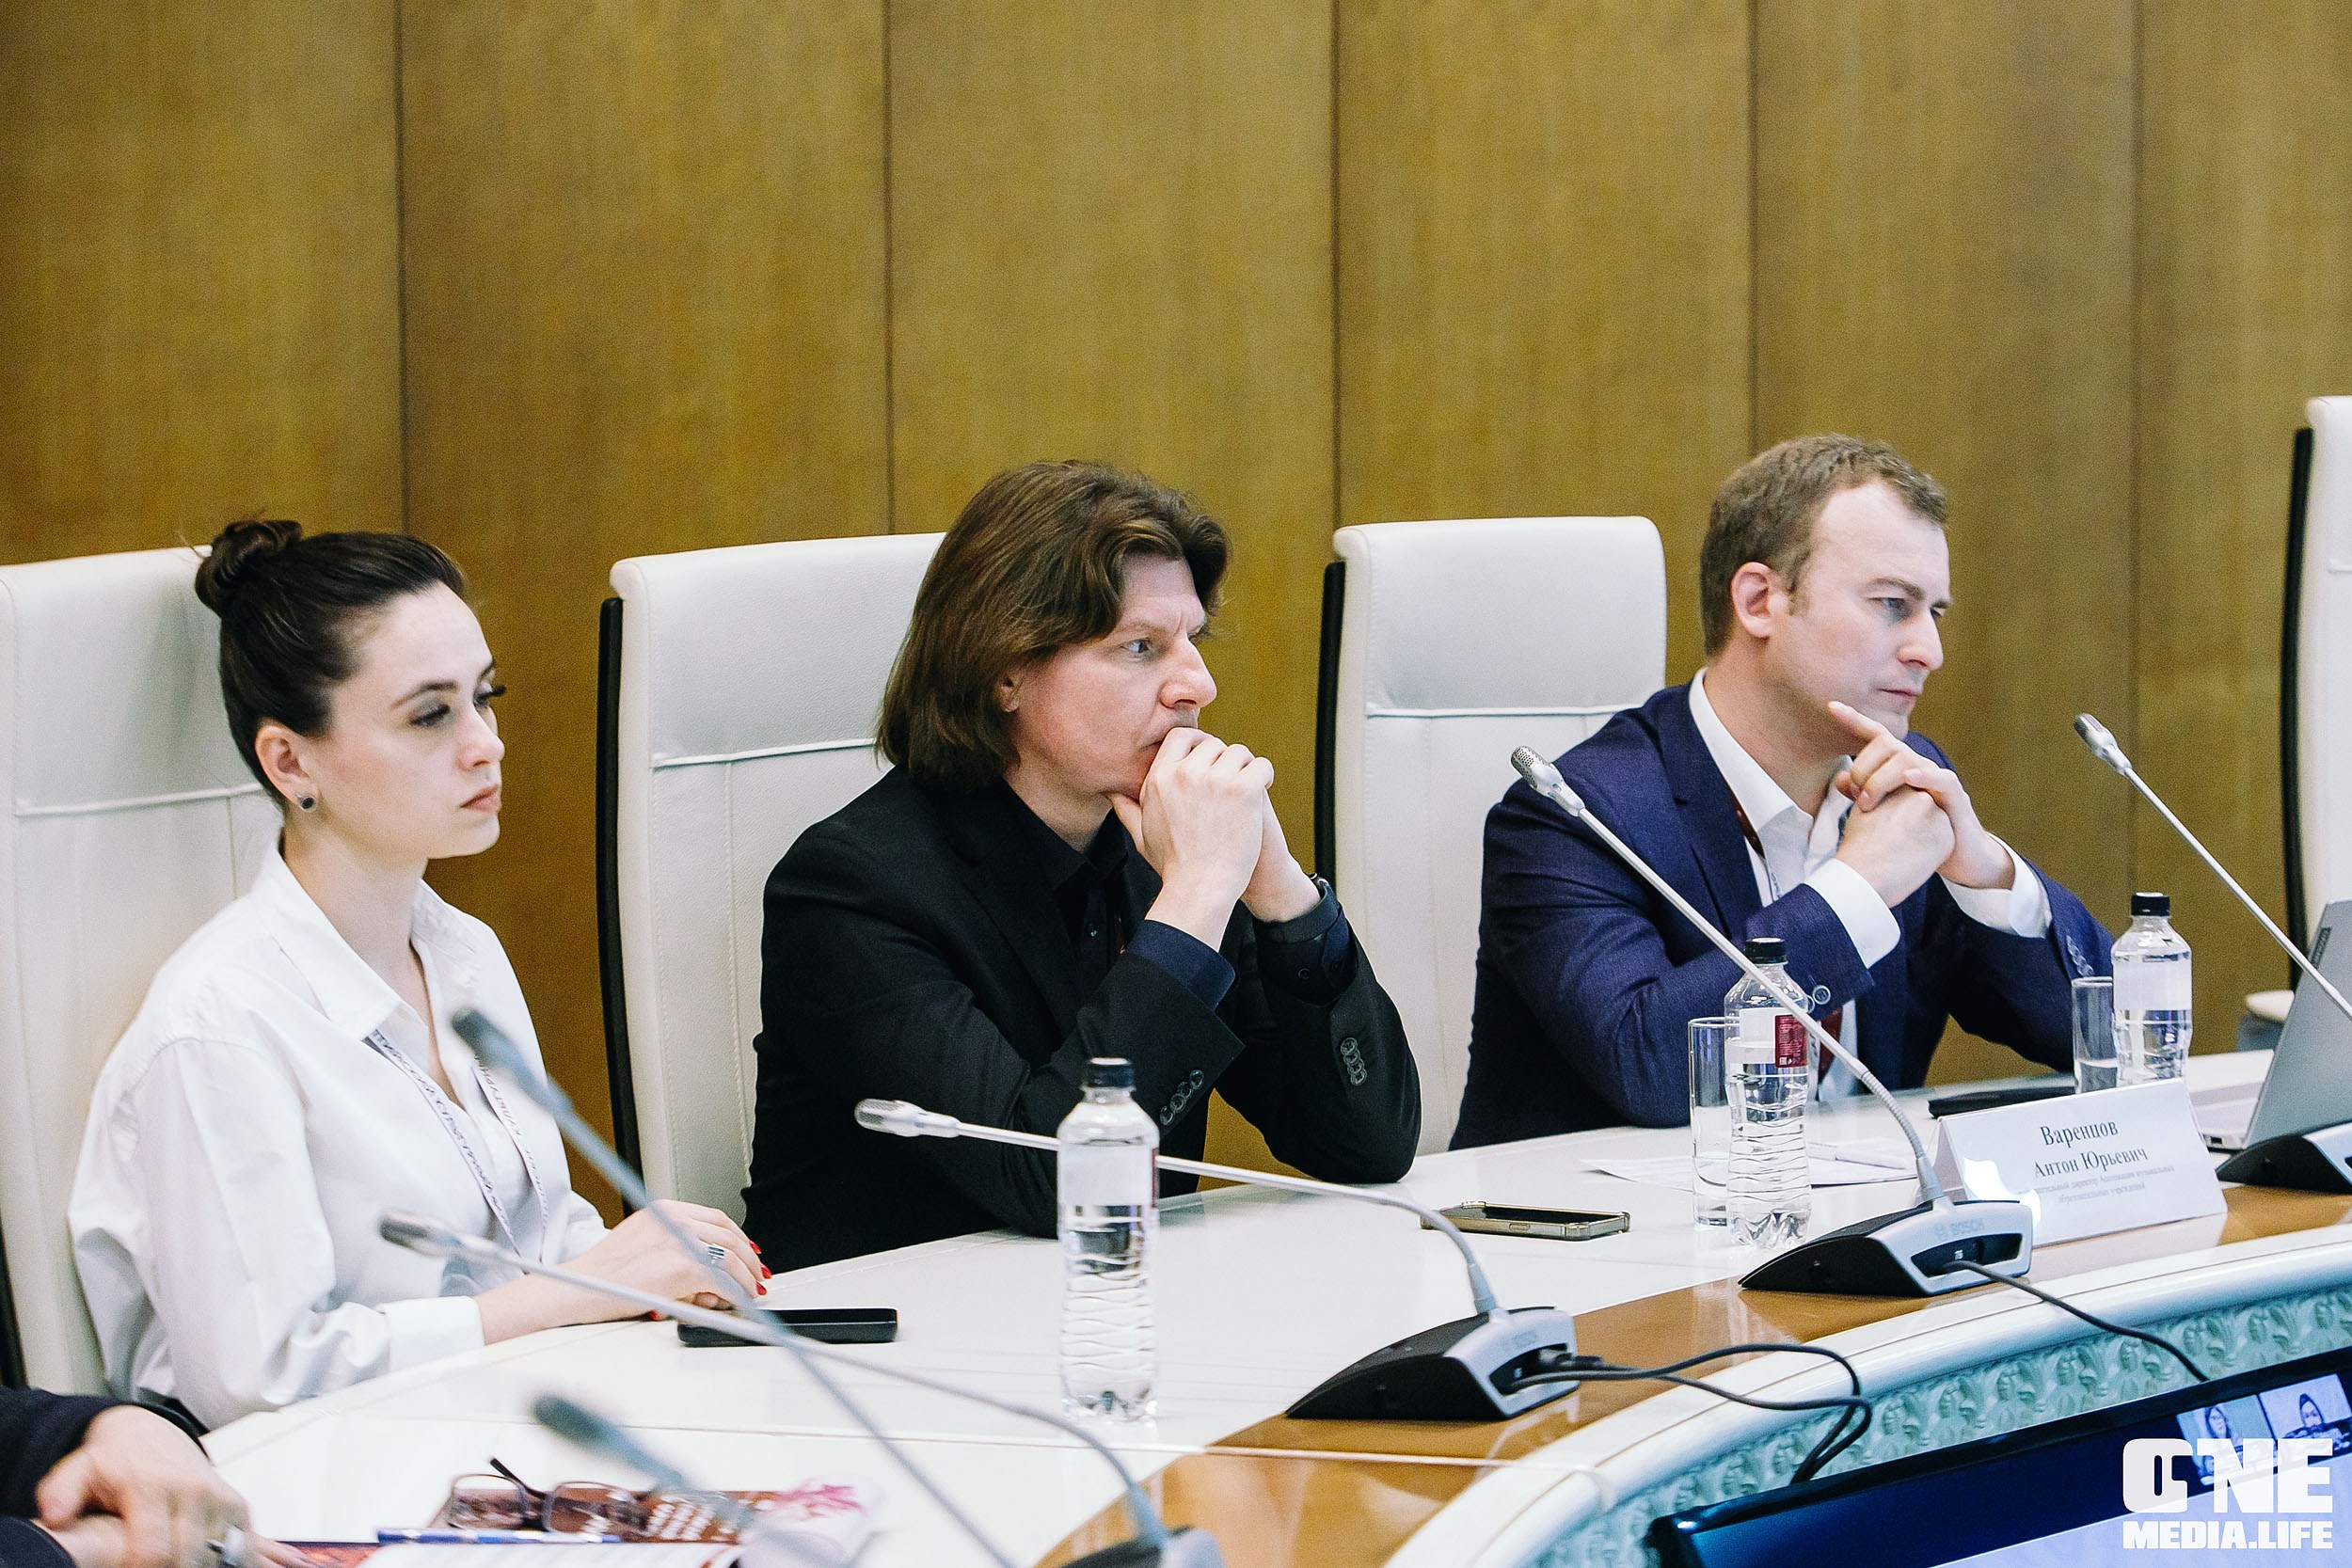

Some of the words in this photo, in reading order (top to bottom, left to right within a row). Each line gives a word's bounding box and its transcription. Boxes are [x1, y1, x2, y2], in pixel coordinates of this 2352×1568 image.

[2040, 1119, 2119, 1148] Варенцов
[2032, 1159, 2079, 1179] Антон
[2081, 1147, 2149, 1173] Юрьевич
